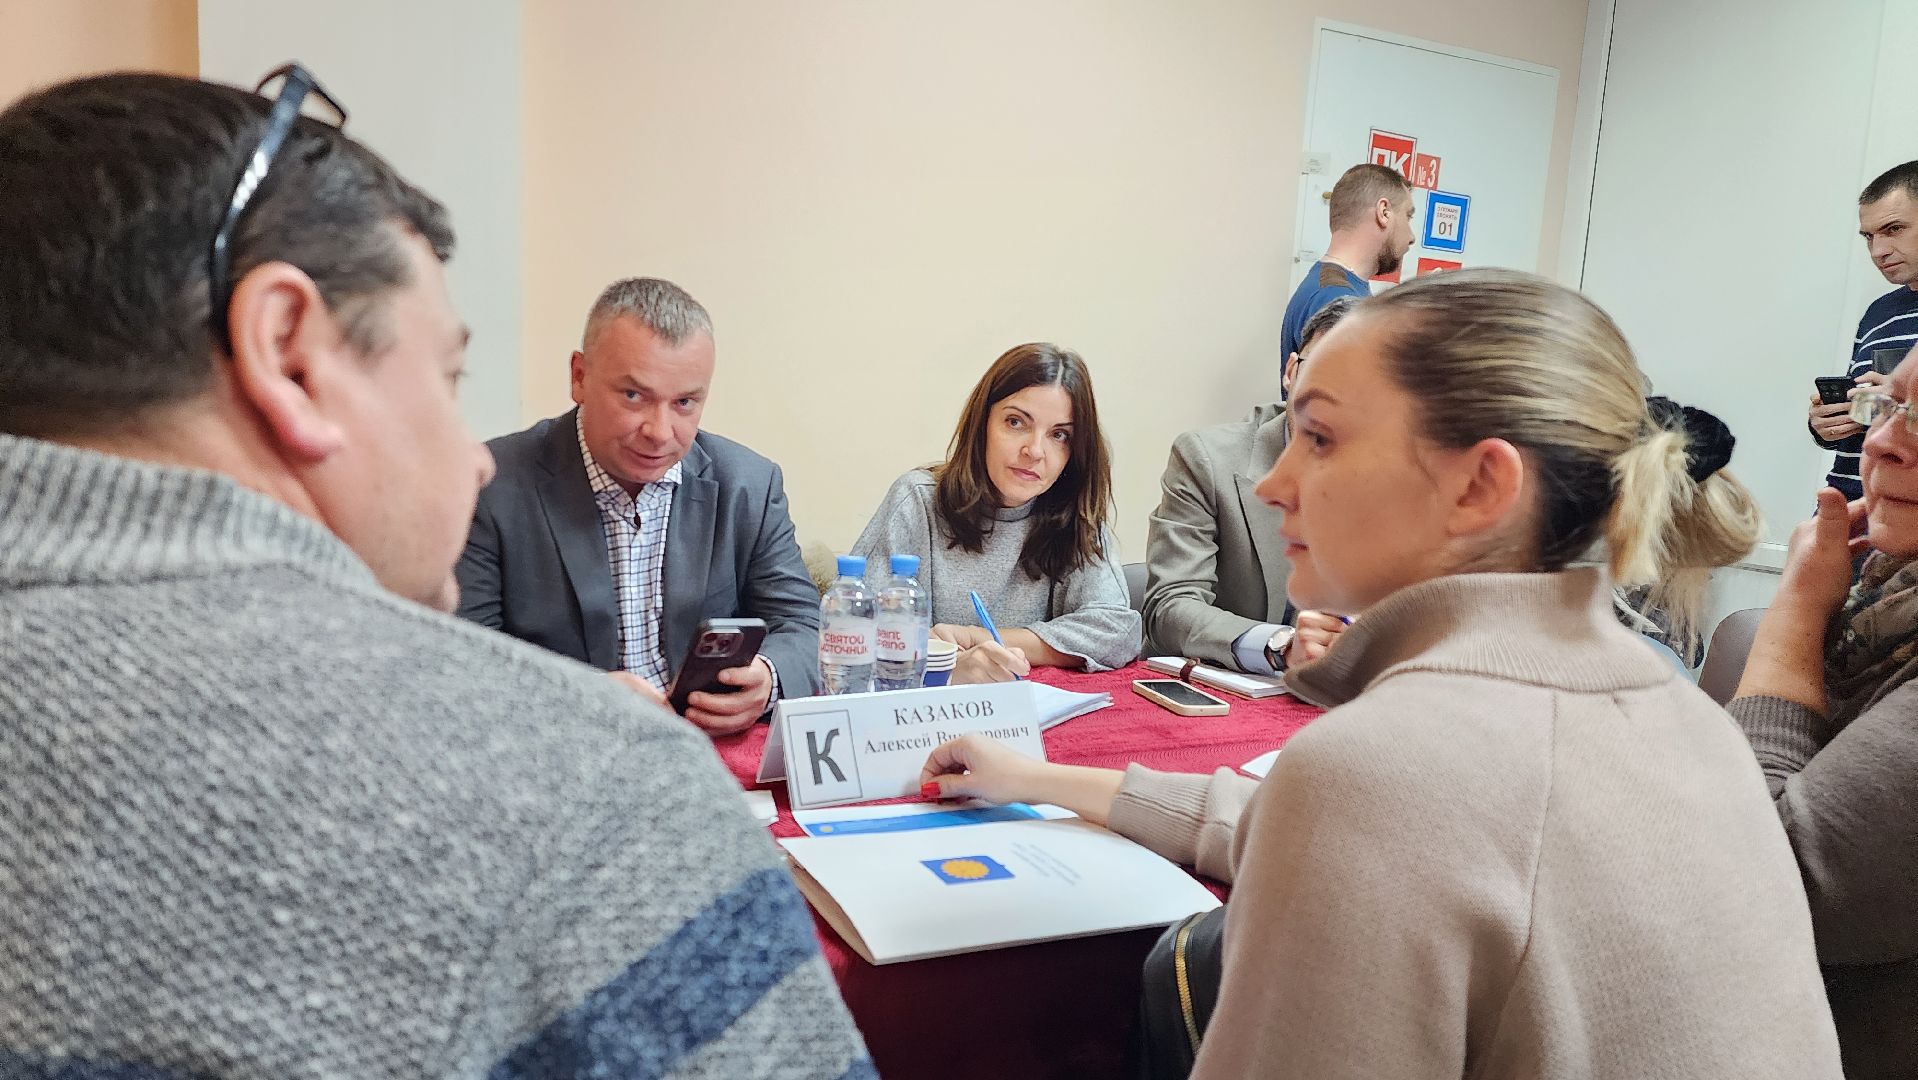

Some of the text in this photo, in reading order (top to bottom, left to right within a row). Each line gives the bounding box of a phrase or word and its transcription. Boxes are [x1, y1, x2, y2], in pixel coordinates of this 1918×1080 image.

[1427, 159, 1437, 188] 3
[1438, 221, 1453, 236] 01
[894, 700, 995, 726] КАЗАКОВ
[865, 733, 932, 754] Алексей
[806, 728, 848, 786] К
